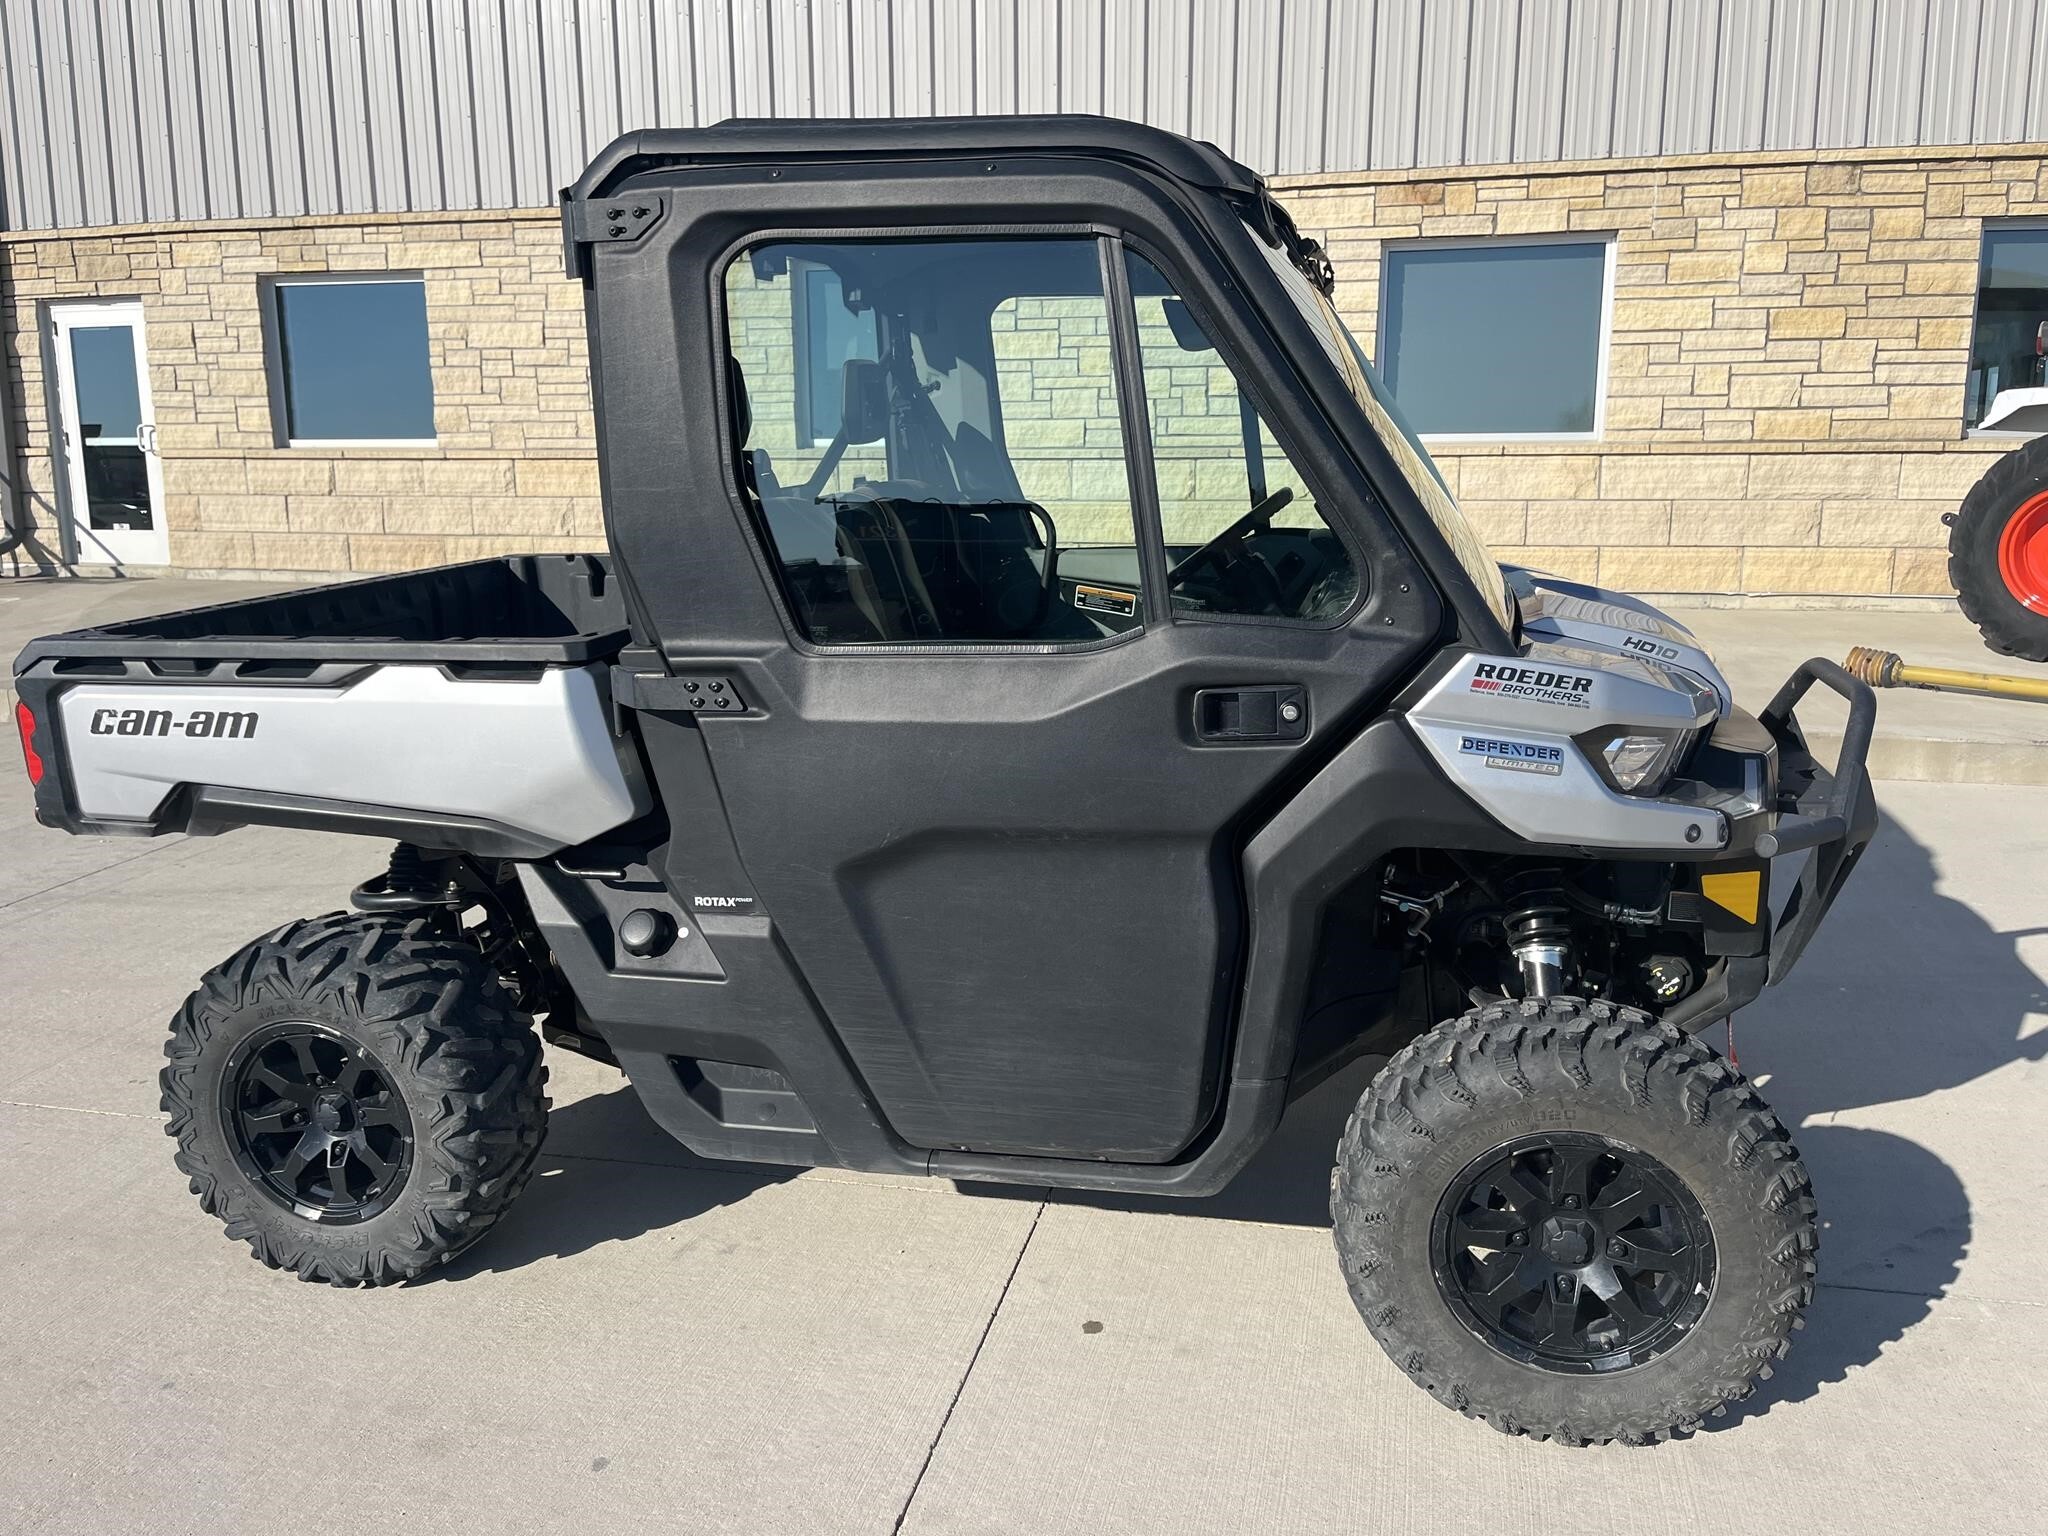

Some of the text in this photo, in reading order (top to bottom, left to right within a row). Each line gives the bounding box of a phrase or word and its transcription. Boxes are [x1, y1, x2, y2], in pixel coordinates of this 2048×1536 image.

[1622, 636, 1679, 660] HD10
[1474, 662, 1593, 693] ROEDER
[1501, 683, 1583, 703] BROTHERS
[90, 708, 259, 739] can-am
[1462, 738, 1562, 761] DEFENDER
[1490, 757, 1557, 773] LIMITED
[694, 896, 736, 907] ROTAX
